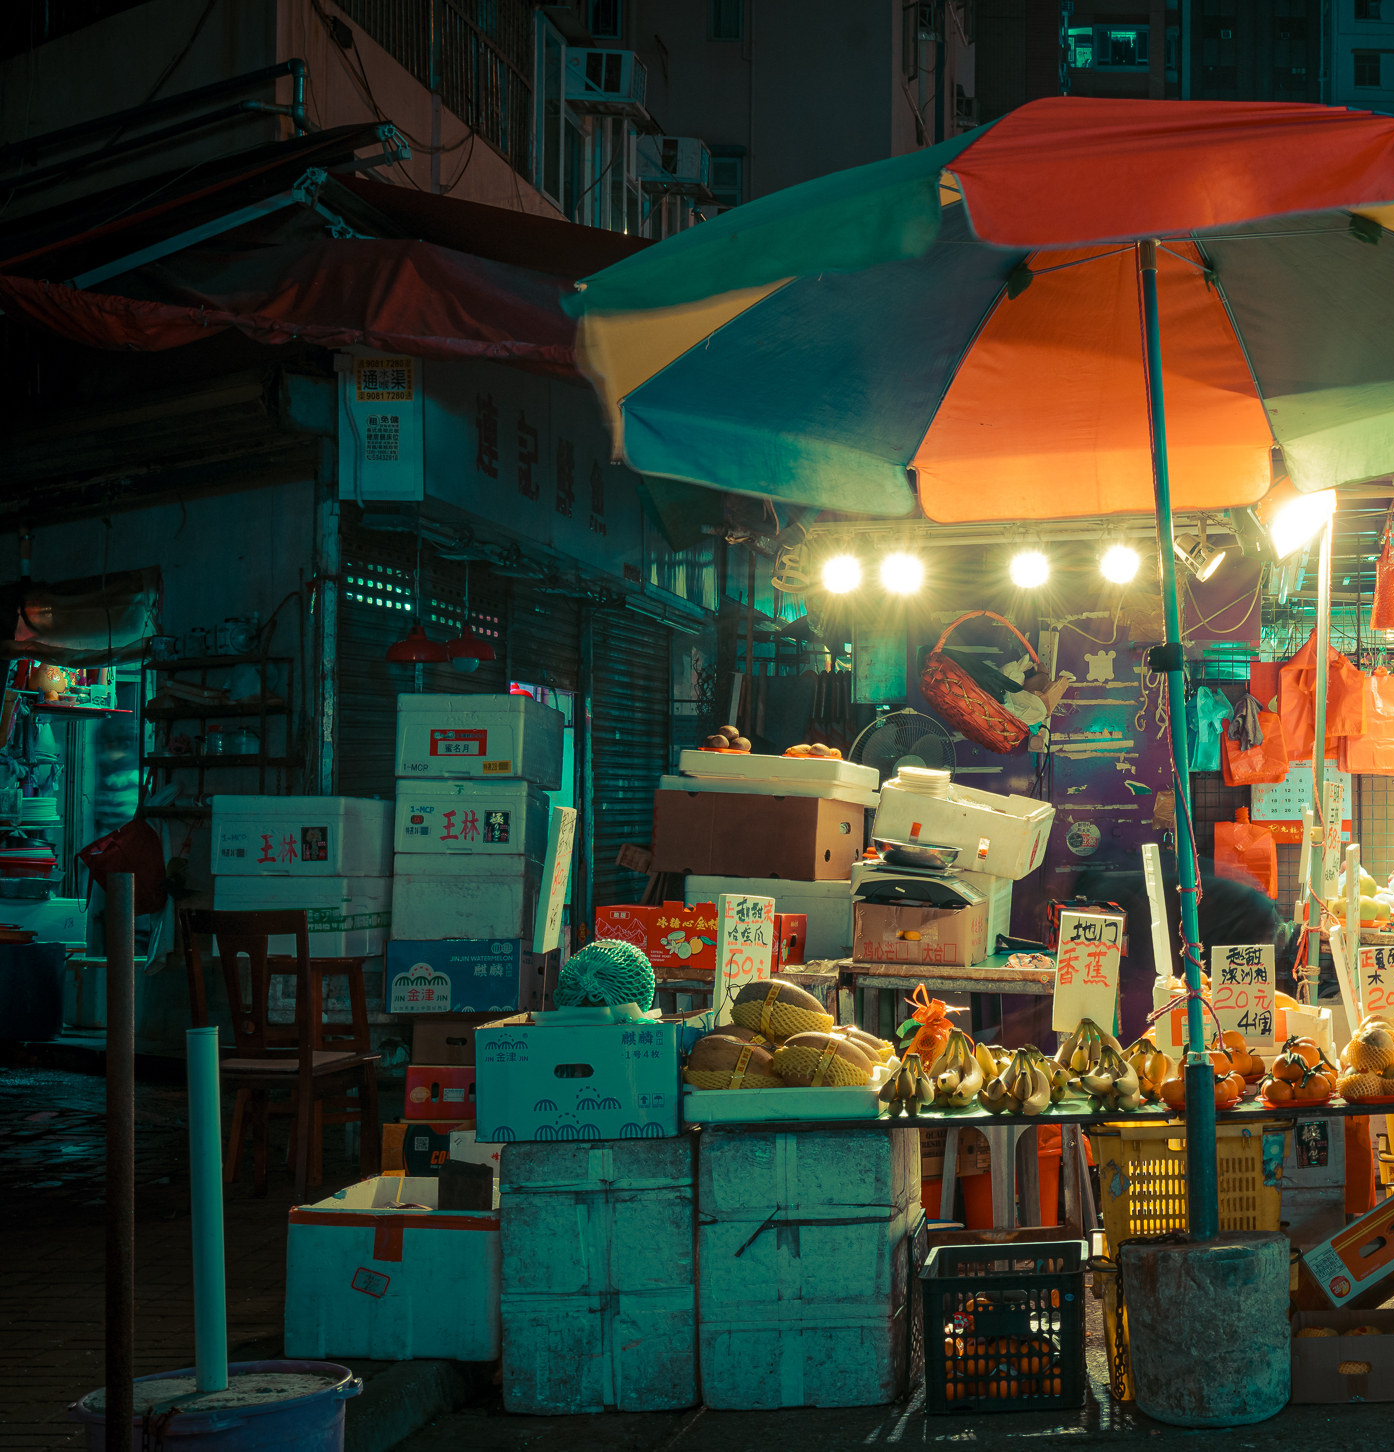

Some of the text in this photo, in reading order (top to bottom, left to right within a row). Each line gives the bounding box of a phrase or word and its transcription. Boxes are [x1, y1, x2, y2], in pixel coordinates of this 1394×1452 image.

[363, 370, 378, 390] 通
[391, 370, 406, 390] 渠
[444, 744, 470, 753] 蜜名月
[410, 806, 434, 814] 1-MCP
[440, 810, 480, 842] 王林
[256, 833, 298, 864] 王林
[863, 941, 894, 960] 鸡心芒
[1058, 948, 1110, 988] 香蕉
[407, 988, 435, 1001] 金津
[1213, 987, 1272, 1010] 20元
[1237, 1010, 1272, 1035] 4個
[496, 1053, 516, 1062] 金津
